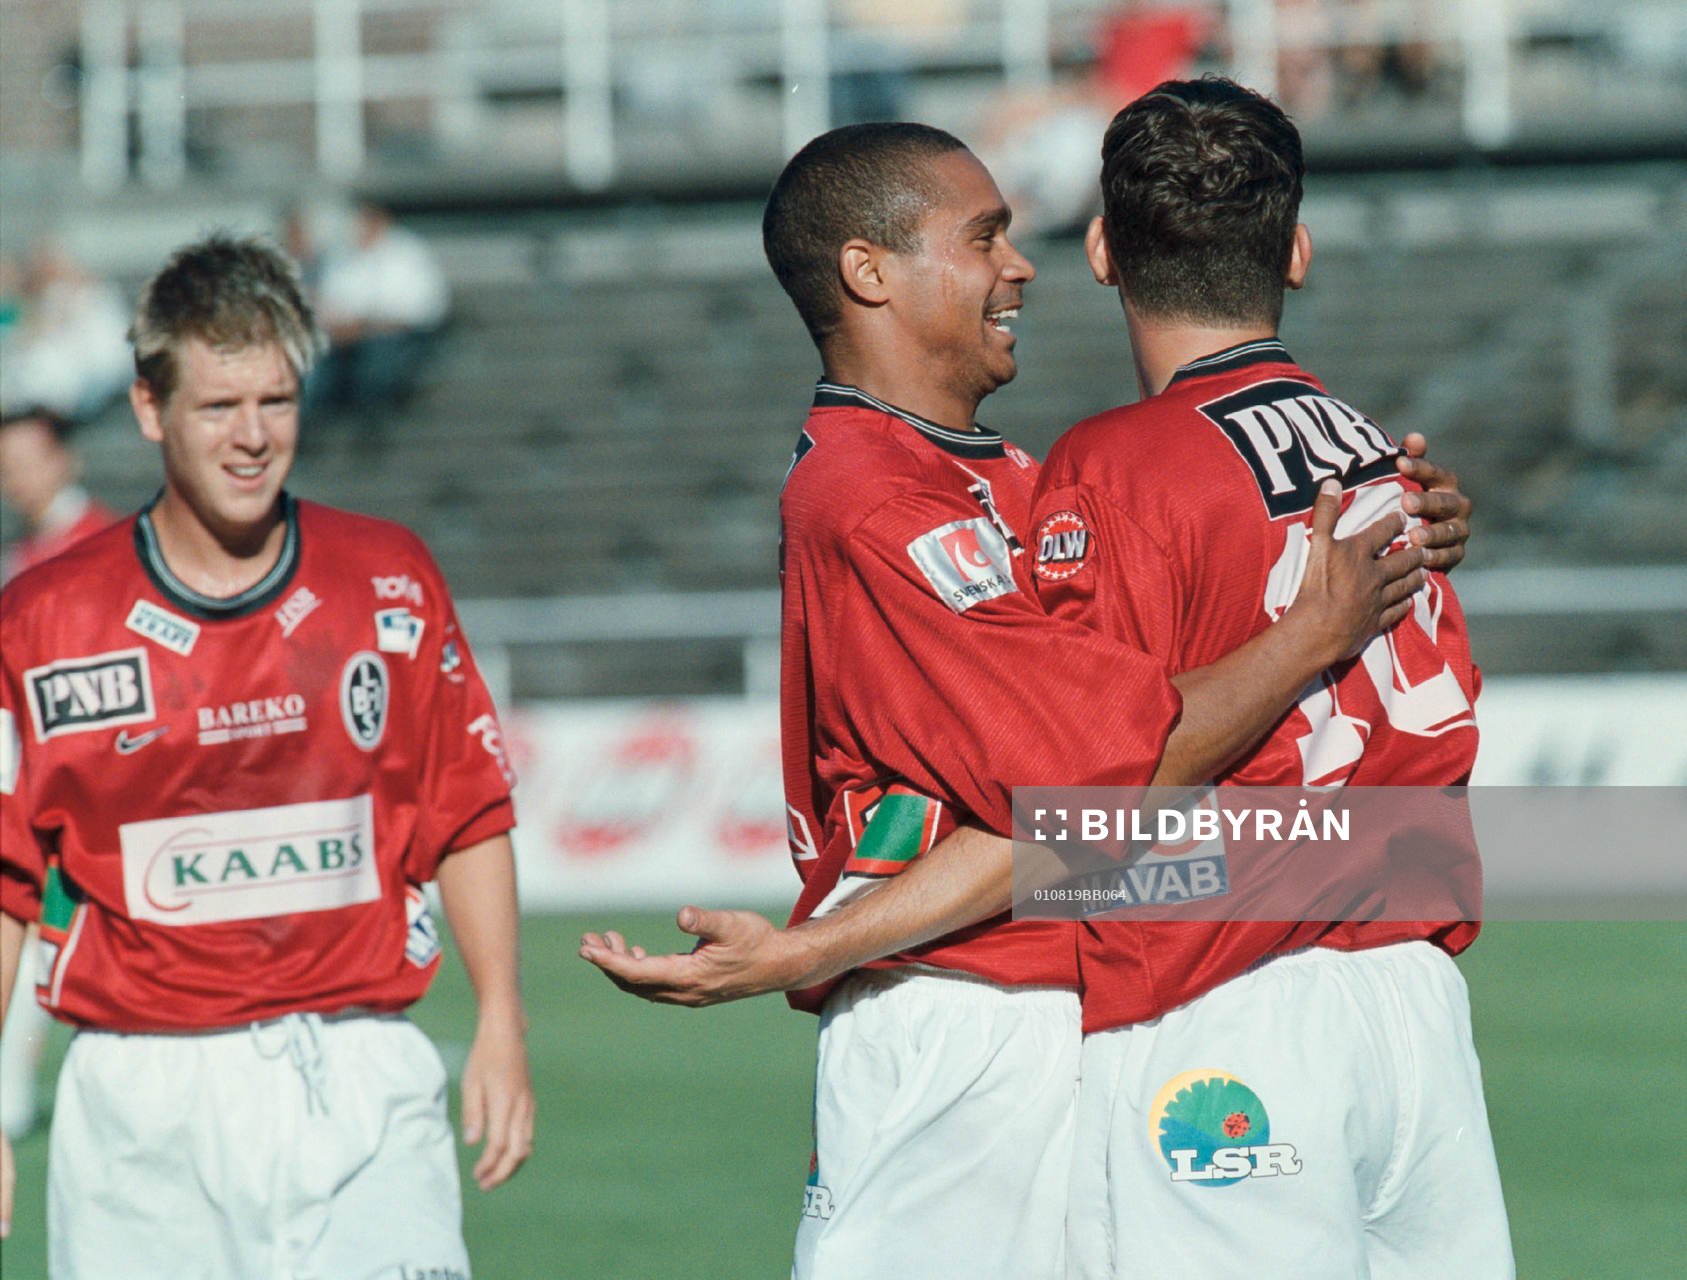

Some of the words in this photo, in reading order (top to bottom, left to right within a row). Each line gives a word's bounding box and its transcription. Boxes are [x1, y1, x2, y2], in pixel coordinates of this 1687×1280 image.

[40, 663, 139, 721] PNB
[197, 693, 306, 730] BAREKO
[171, 833, 364, 887] KAABS
[1170, 1143, 1303, 1182] LSR
